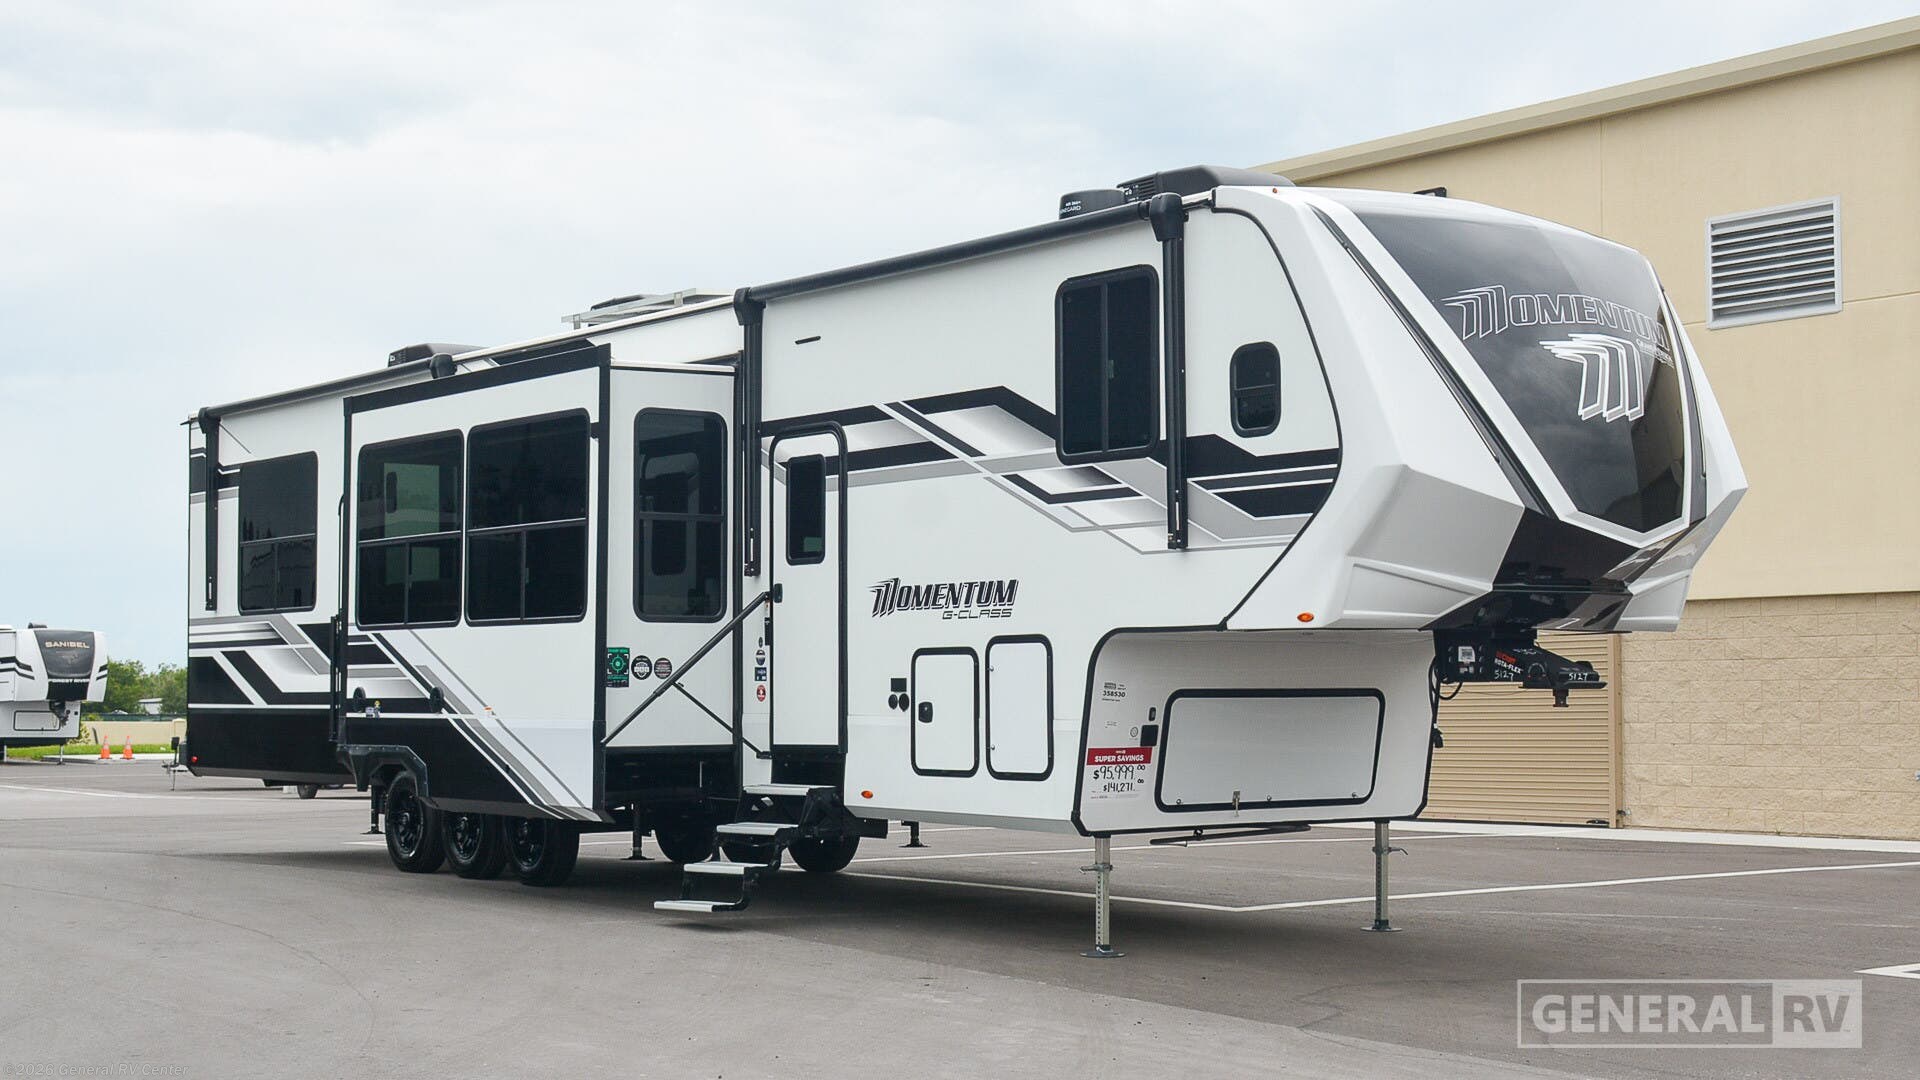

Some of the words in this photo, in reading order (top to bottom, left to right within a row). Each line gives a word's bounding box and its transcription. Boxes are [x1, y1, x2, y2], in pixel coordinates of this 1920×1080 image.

[1442, 285, 1670, 351] MOMENTUM
[867, 577, 1019, 618] MOMENTUM
[942, 608, 1013, 620] G-CLASS
[45, 641, 90, 649] SANIBEL
[1494, 670, 1514, 681] 5127
[1568, 672, 1588, 681] 5127
[1117, 754, 1144, 762] SAVINGS
